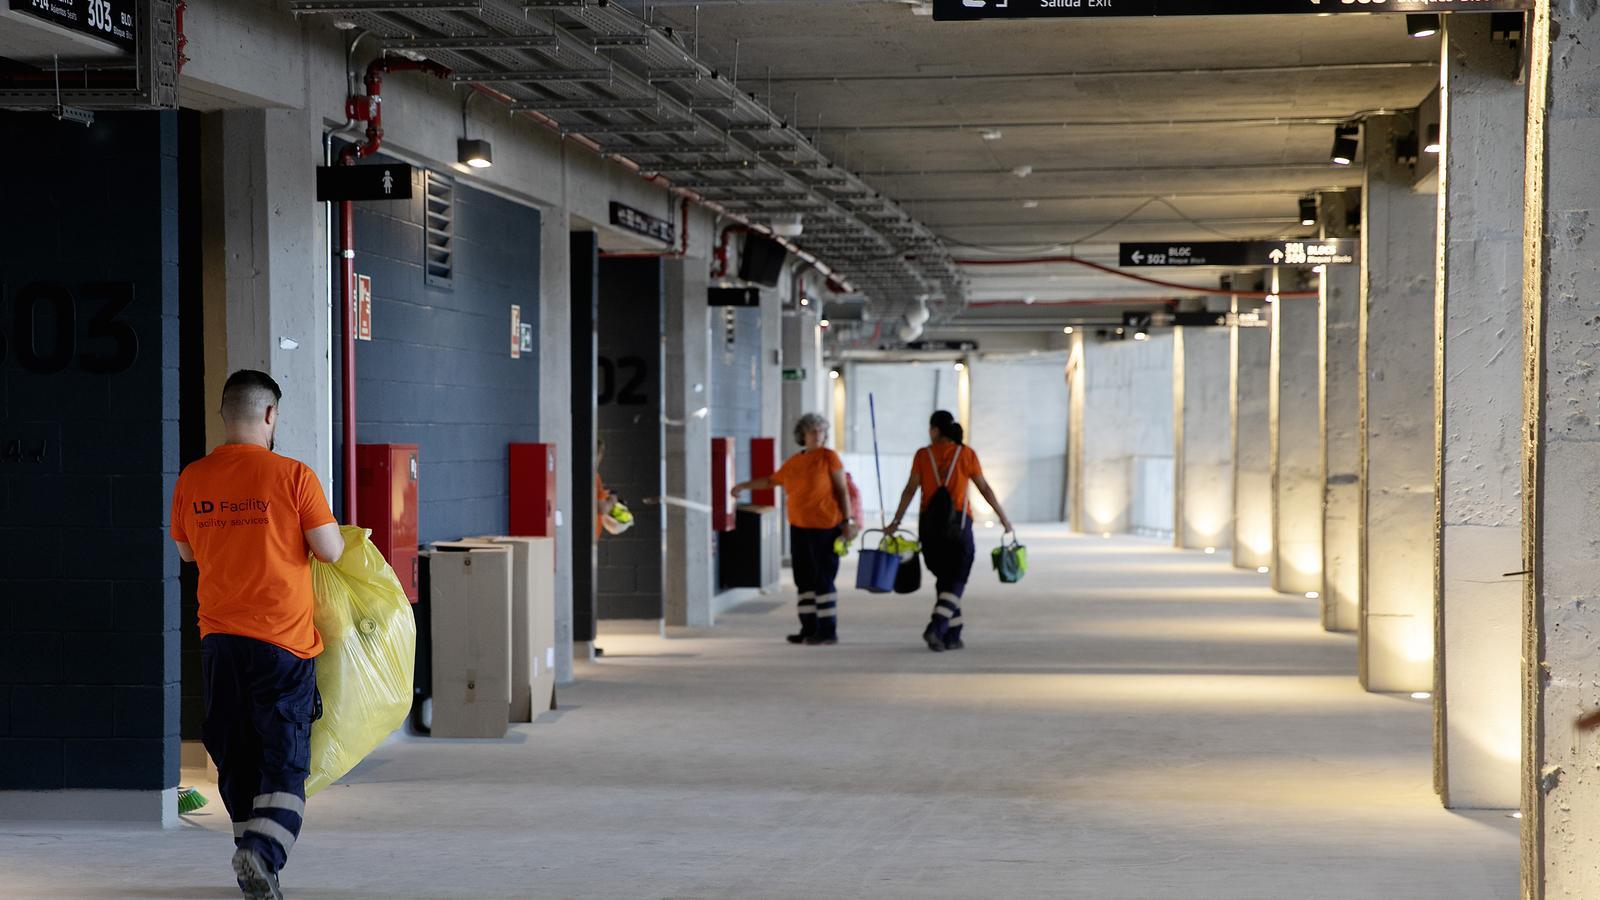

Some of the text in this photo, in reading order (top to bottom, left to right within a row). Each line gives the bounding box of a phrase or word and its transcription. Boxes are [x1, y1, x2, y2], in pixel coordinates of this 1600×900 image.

[87, 0, 113, 32] 303
[1168, 246, 1192, 257] BLOC
[0, 281, 139, 375] 03
[193, 498, 271, 514] LD Facility
[231, 516, 270, 527] services
